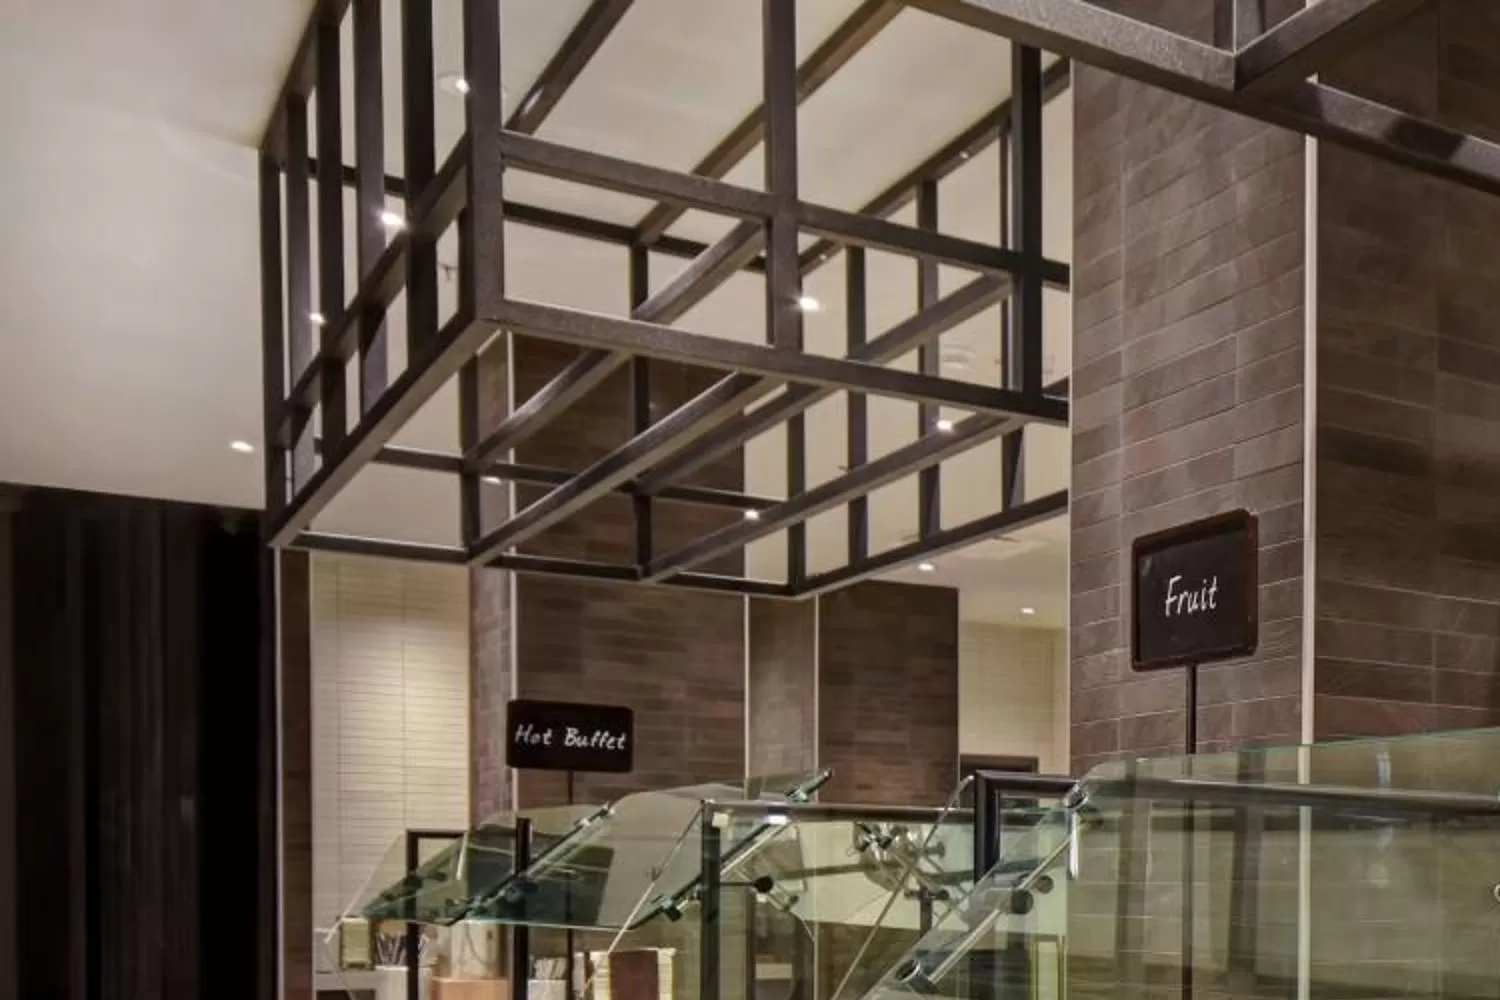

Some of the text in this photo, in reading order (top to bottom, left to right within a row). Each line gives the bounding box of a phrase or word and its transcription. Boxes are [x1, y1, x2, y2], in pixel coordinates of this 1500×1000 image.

[1164, 574, 1219, 618] Fruit
[514, 723, 627, 750] Hot Buffet
